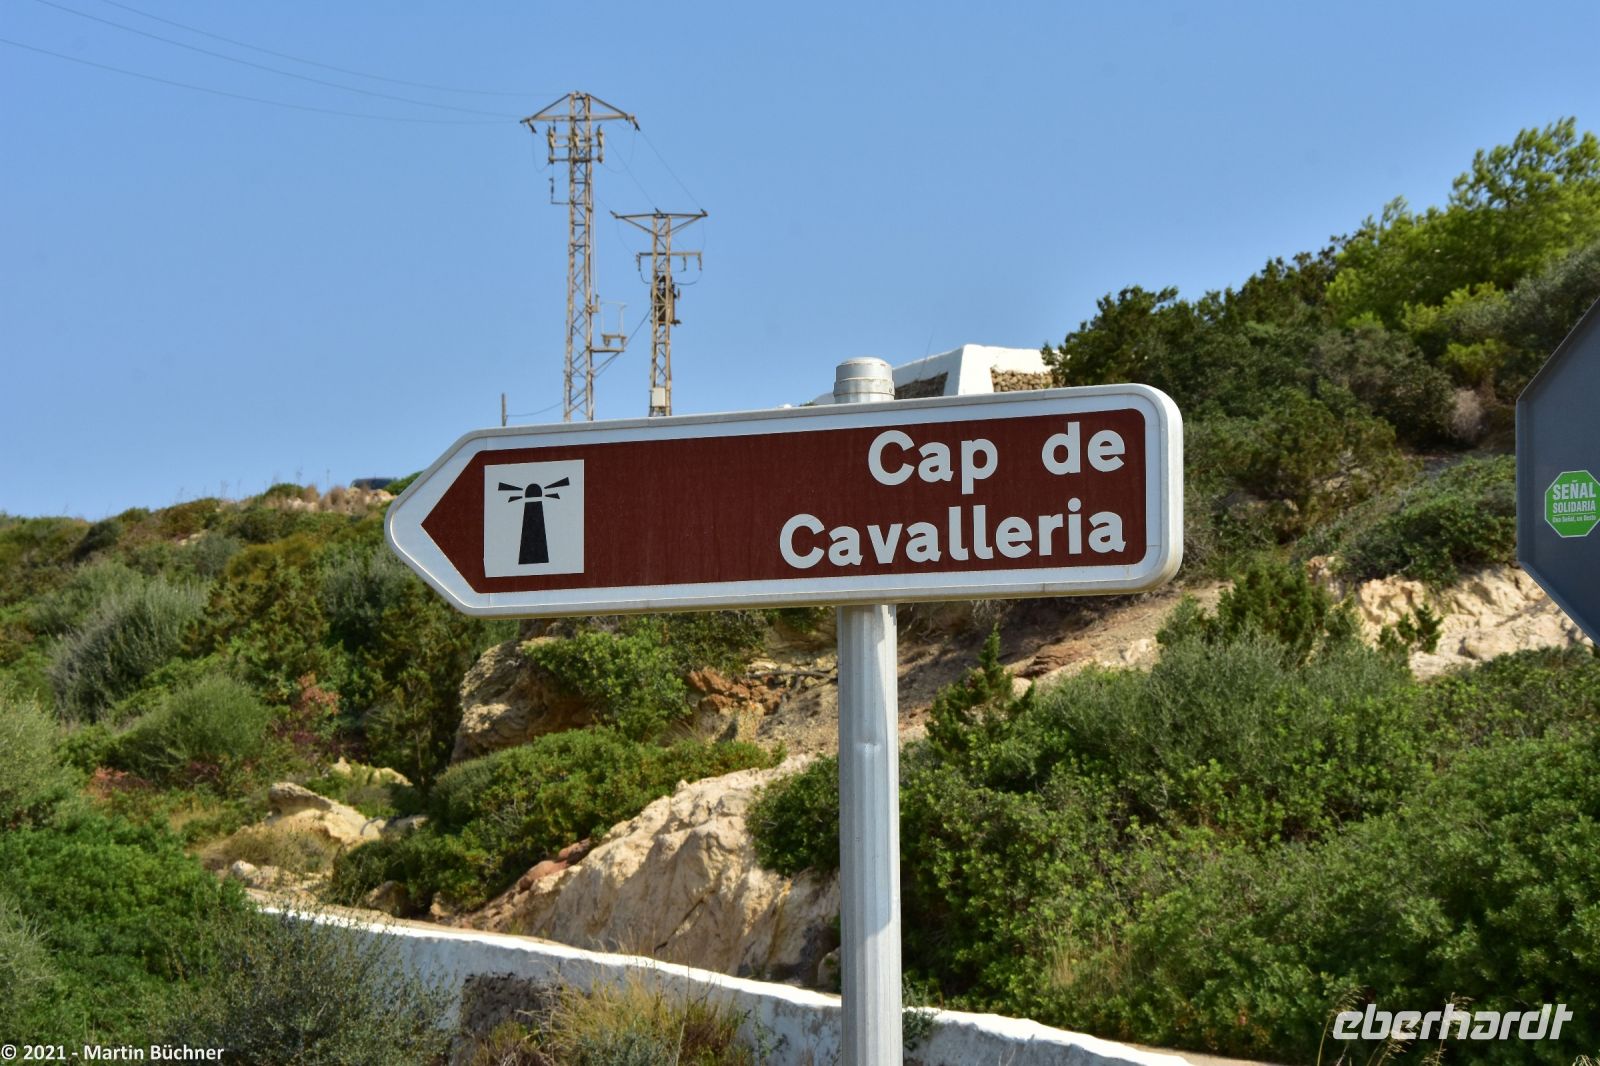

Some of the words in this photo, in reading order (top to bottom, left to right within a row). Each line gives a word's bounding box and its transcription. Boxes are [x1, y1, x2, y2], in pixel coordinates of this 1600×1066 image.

[868, 430, 998, 495] Cap
[1041, 421, 1126, 475] de
[1552, 480, 1596, 500] SEÑAL
[1552, 500, 1596, 513] SOLIDARIA
[779, 497, 1126, 569] Cavalleria
